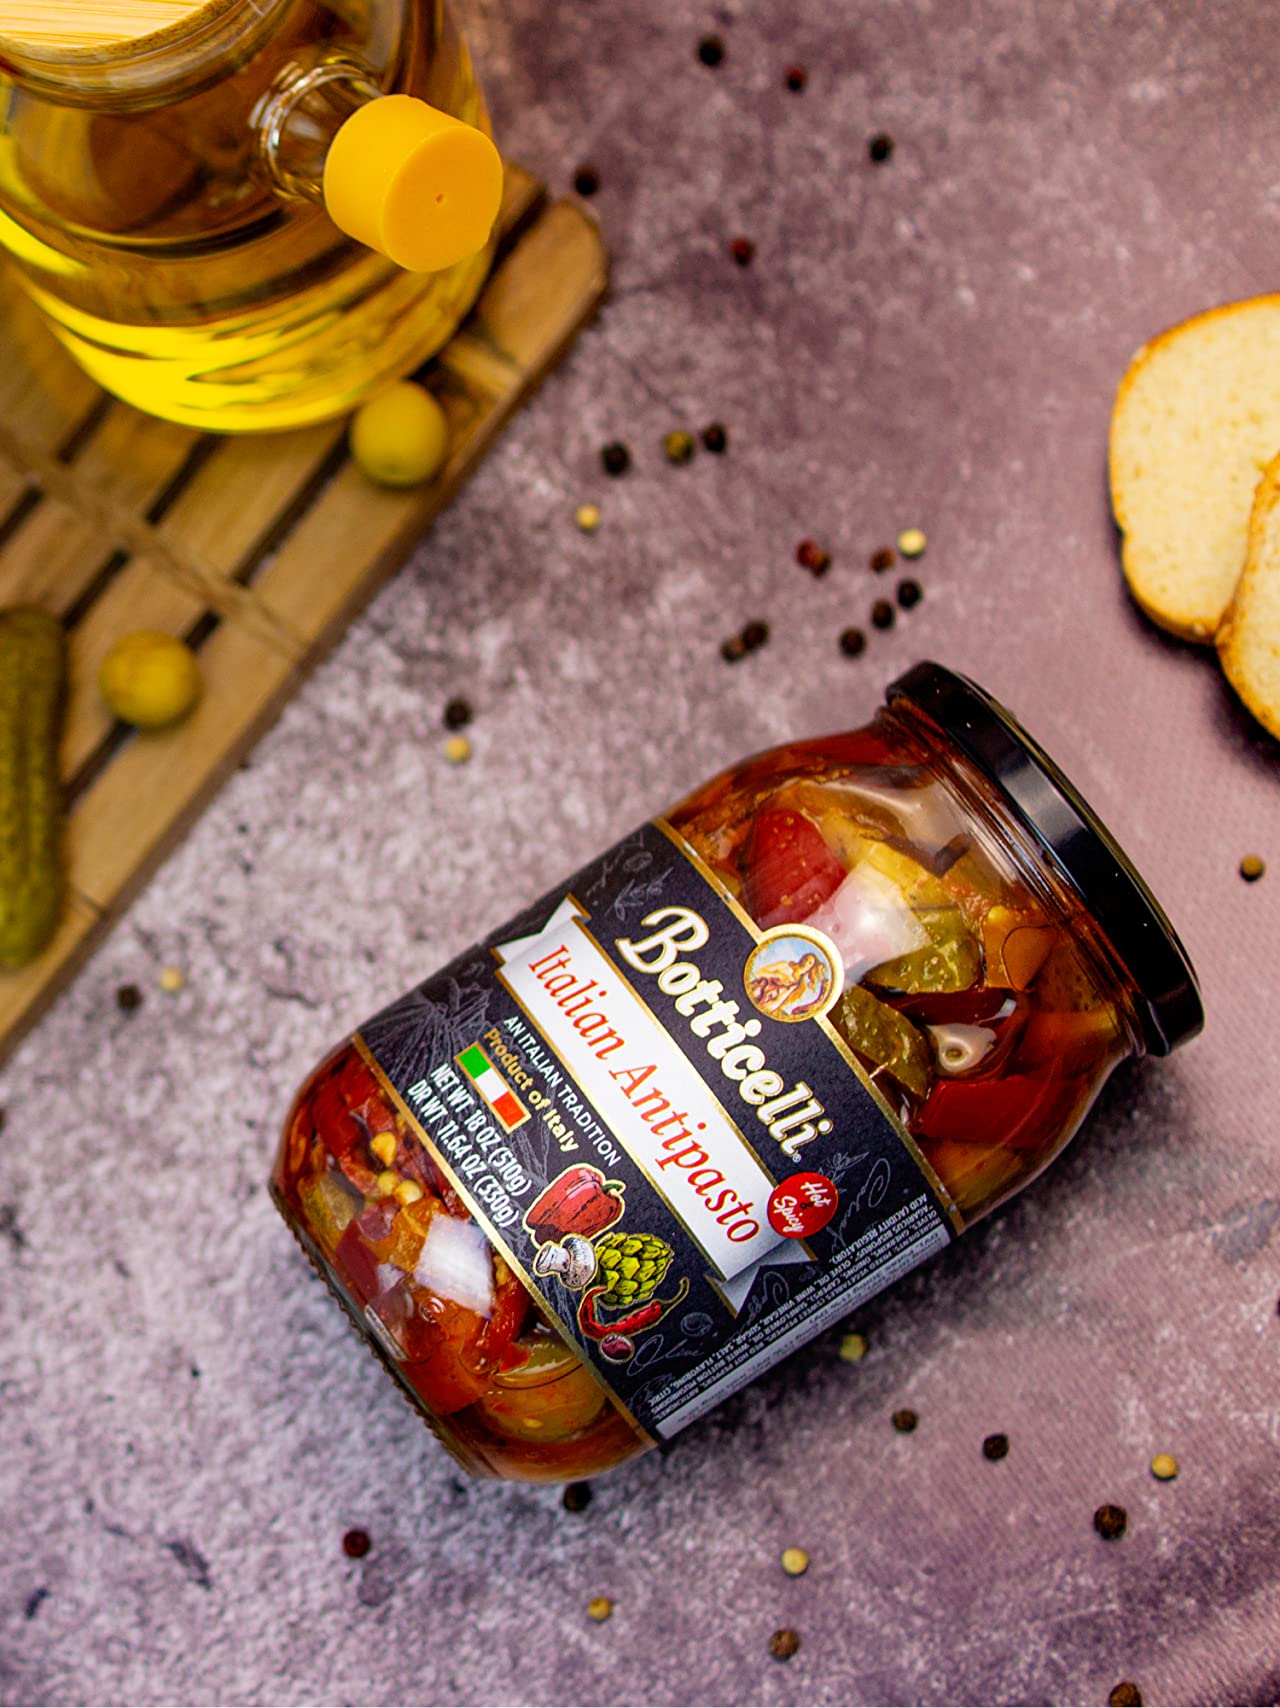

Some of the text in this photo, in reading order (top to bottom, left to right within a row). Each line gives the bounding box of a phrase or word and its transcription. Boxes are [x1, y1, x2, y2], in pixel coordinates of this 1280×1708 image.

[484, 1028, 580, 1153] Product of Italy
[503, 1016, 622, 1167] AN ITALIAN TRADITION
[529, 945, 760, 1243] Italian Antipasto
[430, 1063, 533, 1197] NET WT 18 OZ (510g)
[407, 1079, 520, 1227] DR WT 11.64 OZ (330g)
[800, 1182, 831, 1207] Hot
[773, 1195, 804, 1232] Spicy
[891, 1200, 933, 1234] "AGARICUS
[908, 1208, 937, 1232] OLIVES,
[828, 1192, 928, 1267] ACID (ACIDITY REGULATOR).
[869, 1227, 909, 1259] GHERKINS,
[891, 1215, 941, 1254] INGREDIENTS:
[829, 1258, 851, 1278] OLIVE
[839, 1254, 871, 1280] ONIONS,
[868, 1250, 893, 1271] MIXED
[793, 1283, 815, 1303] WINE
[806, 1275, 841, 1304] CAPERS),
[812, 1272, 830, 1289] OIL,
[825, 1266, 869, 1301] VEGETABLES
[758, 1296, 795, 1328] VINEGAR,
[763, 1299, 808, 1335] SUNFLOWER
[797, 1297, 825, 1320] (SWEET
[732, 1321, 761, 1347] SUGAR,
[748, 1340, 764, 1355] RED
[711, 1340, 734, 1361] SALT,
[725, 1341, 749, 1362] WHITE
[733, 1351, 749, 1365] HOT
[669, 1354, 714, 1391] FLAVORING,
[696, 1358, 726, 1383] BUTTON
[647, 1385, 671, 1407] CITRIC
